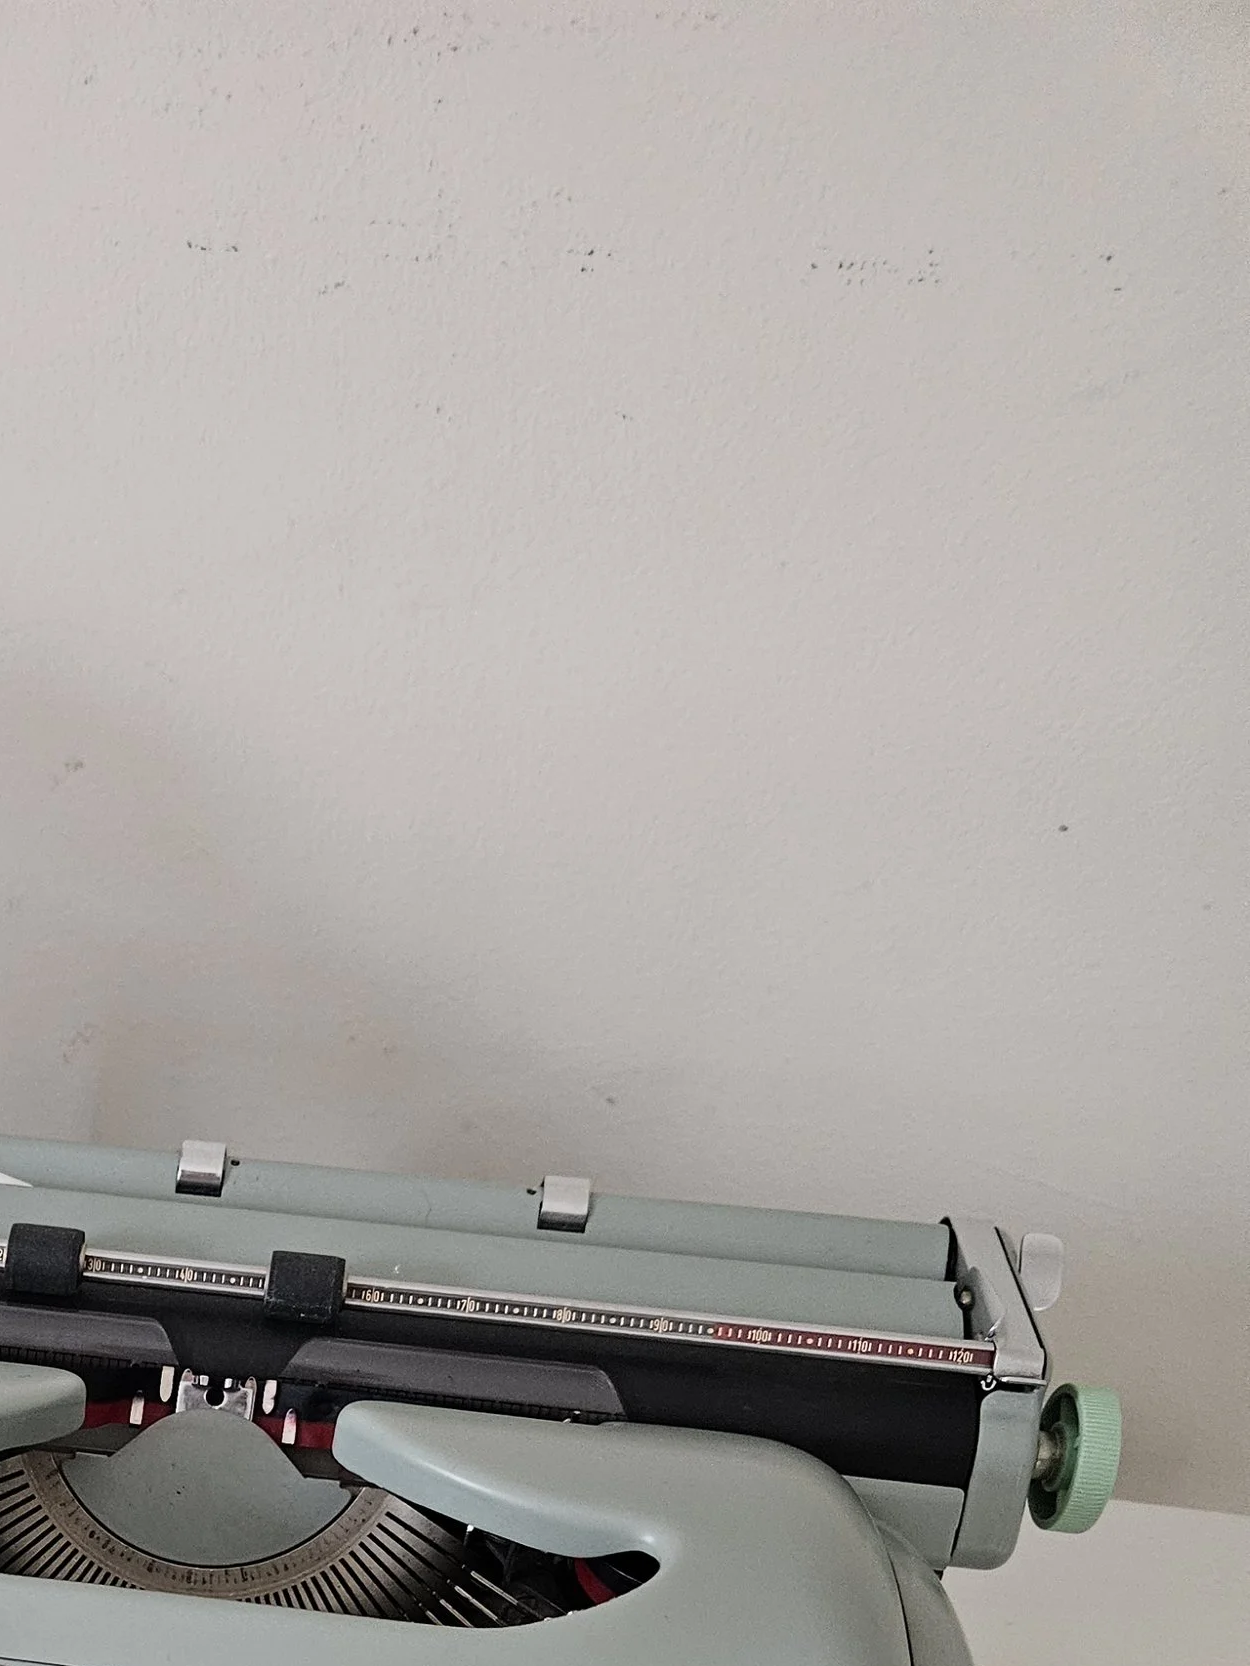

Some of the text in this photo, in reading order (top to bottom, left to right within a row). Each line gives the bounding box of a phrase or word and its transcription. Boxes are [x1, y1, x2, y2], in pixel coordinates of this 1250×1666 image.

[179, 1268, 193, 1283] 40
[365, 1289, 380, 1303] 60
[461, 1298, 475, 1312] 70
[556, 1307, 572, 1322] 80
[653, 1317, 668, 1332] 90
[751, 1328, 769, 1343] 100
[851, 1339, 869, 1353] 110
[952, 1349, 970, 1364] 120
